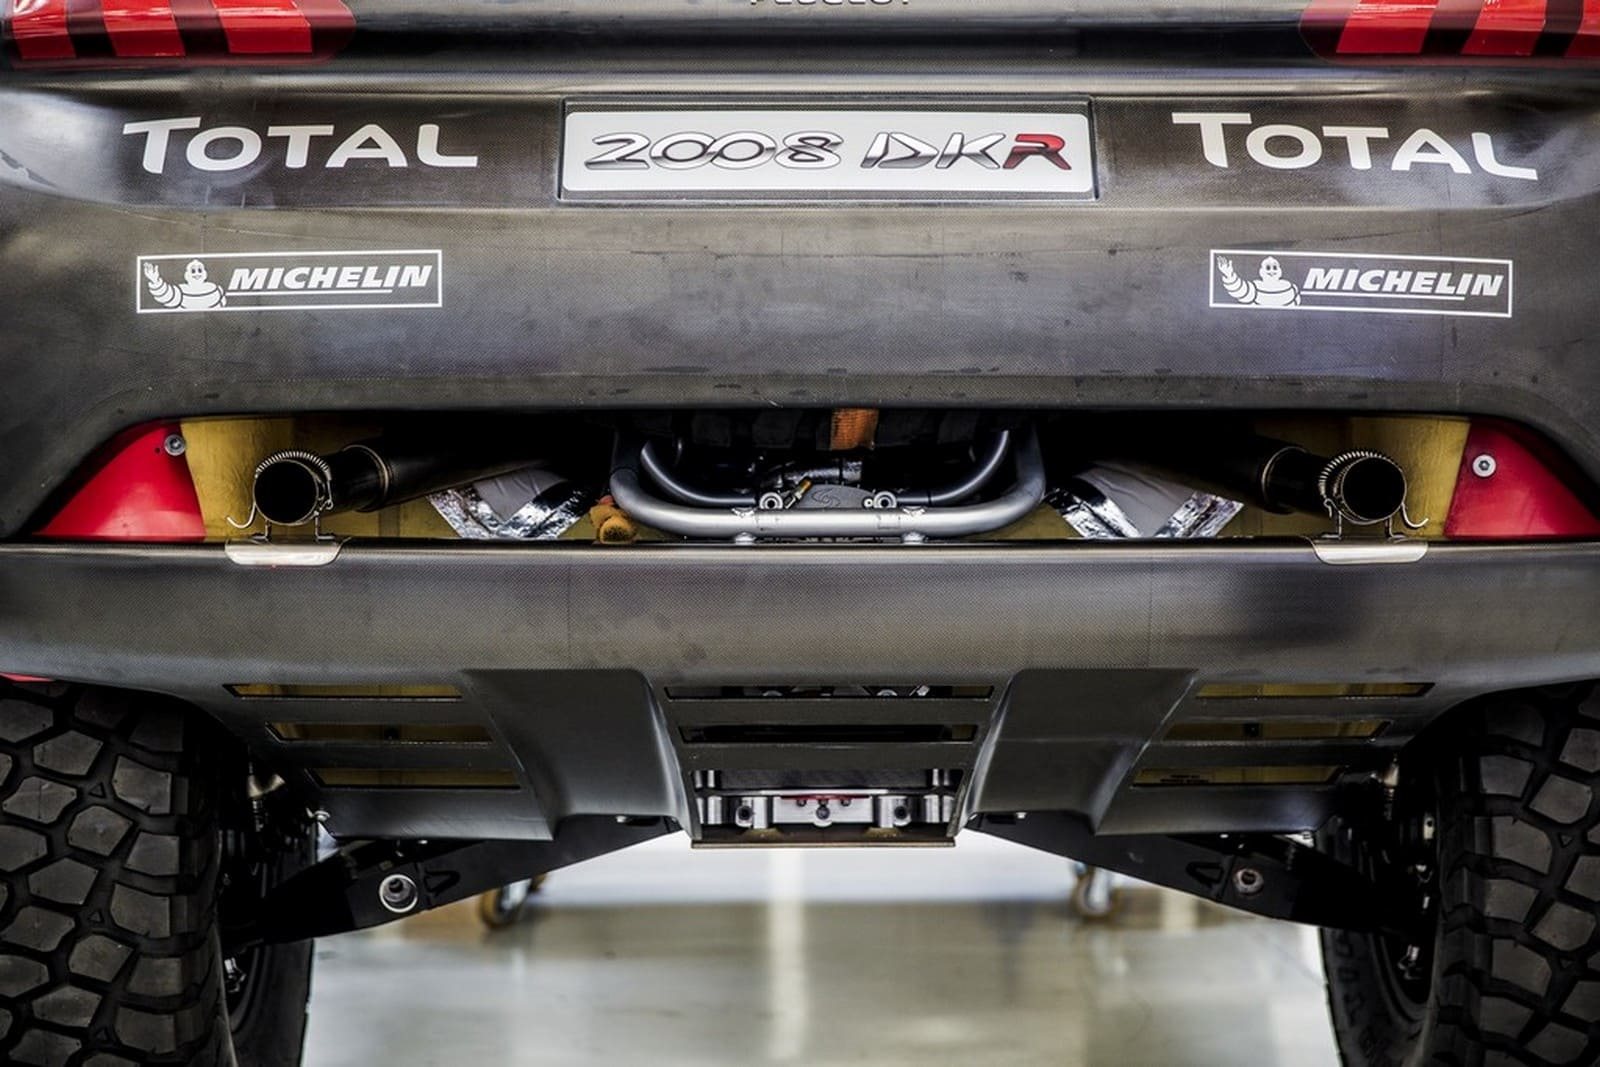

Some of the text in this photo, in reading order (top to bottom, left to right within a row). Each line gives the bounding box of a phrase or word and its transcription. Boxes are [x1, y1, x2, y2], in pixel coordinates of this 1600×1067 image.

[122, 116, 479, 175] TOTAL
[584, 130, 1072, 171] 2008 DKR
[1171, 111, 1539, 182] TOTAL
[227, 264, 434, 290] MICHELIN
[1301, 266, 1505, 297] MICHELIN
